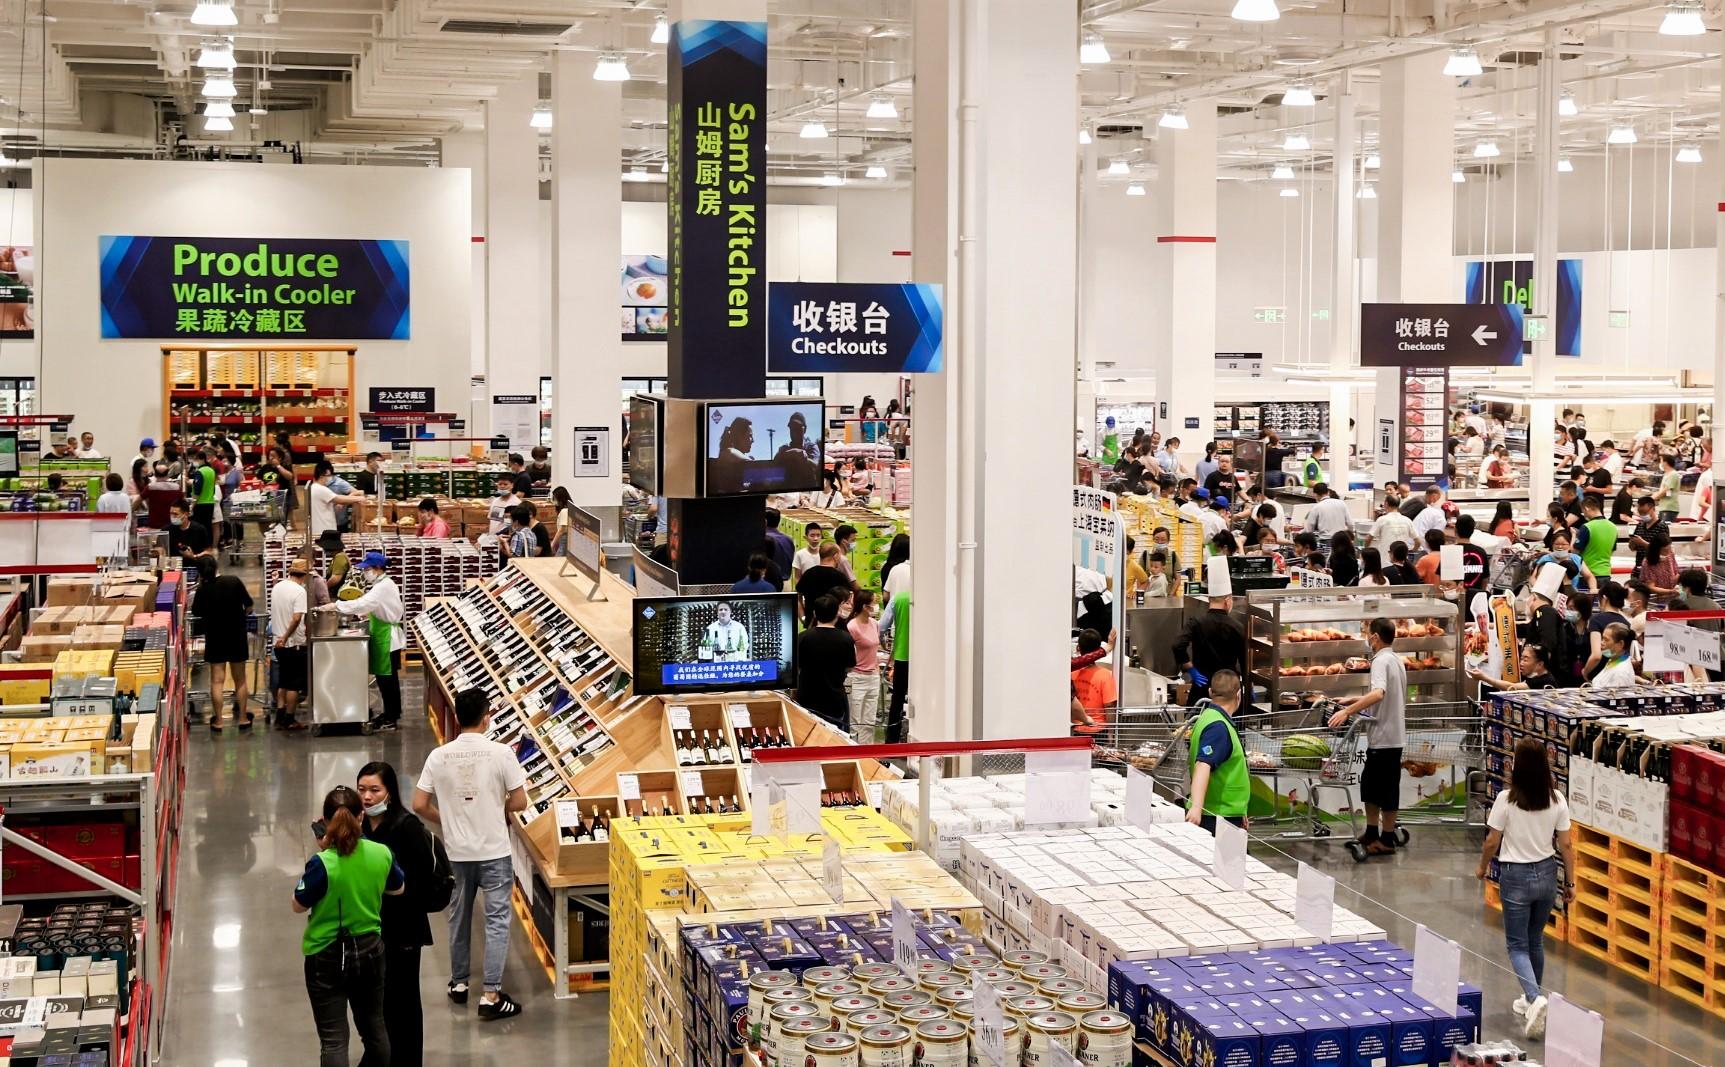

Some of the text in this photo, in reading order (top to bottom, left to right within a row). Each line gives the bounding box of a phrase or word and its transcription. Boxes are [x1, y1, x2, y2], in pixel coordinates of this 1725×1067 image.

[696, 101, 724, 216] 山姆厨房
[728, 102, 756, 328] Sam's Kitchen
[173, 244, 339, 278] Produce
[172, 282, 356, 305] Walk-in Cooler
[175, 308, 307, 333] 果蔬冷藏区
[792, 300, 891, 335] 收银台
[1395, 317, 1450, 339] 收银台
[791, 337, 887, 356] Checkouts
[1398, 341, 1445, 352] Checkouts
[379, 391, 426, 400] 步入式冷藏区
